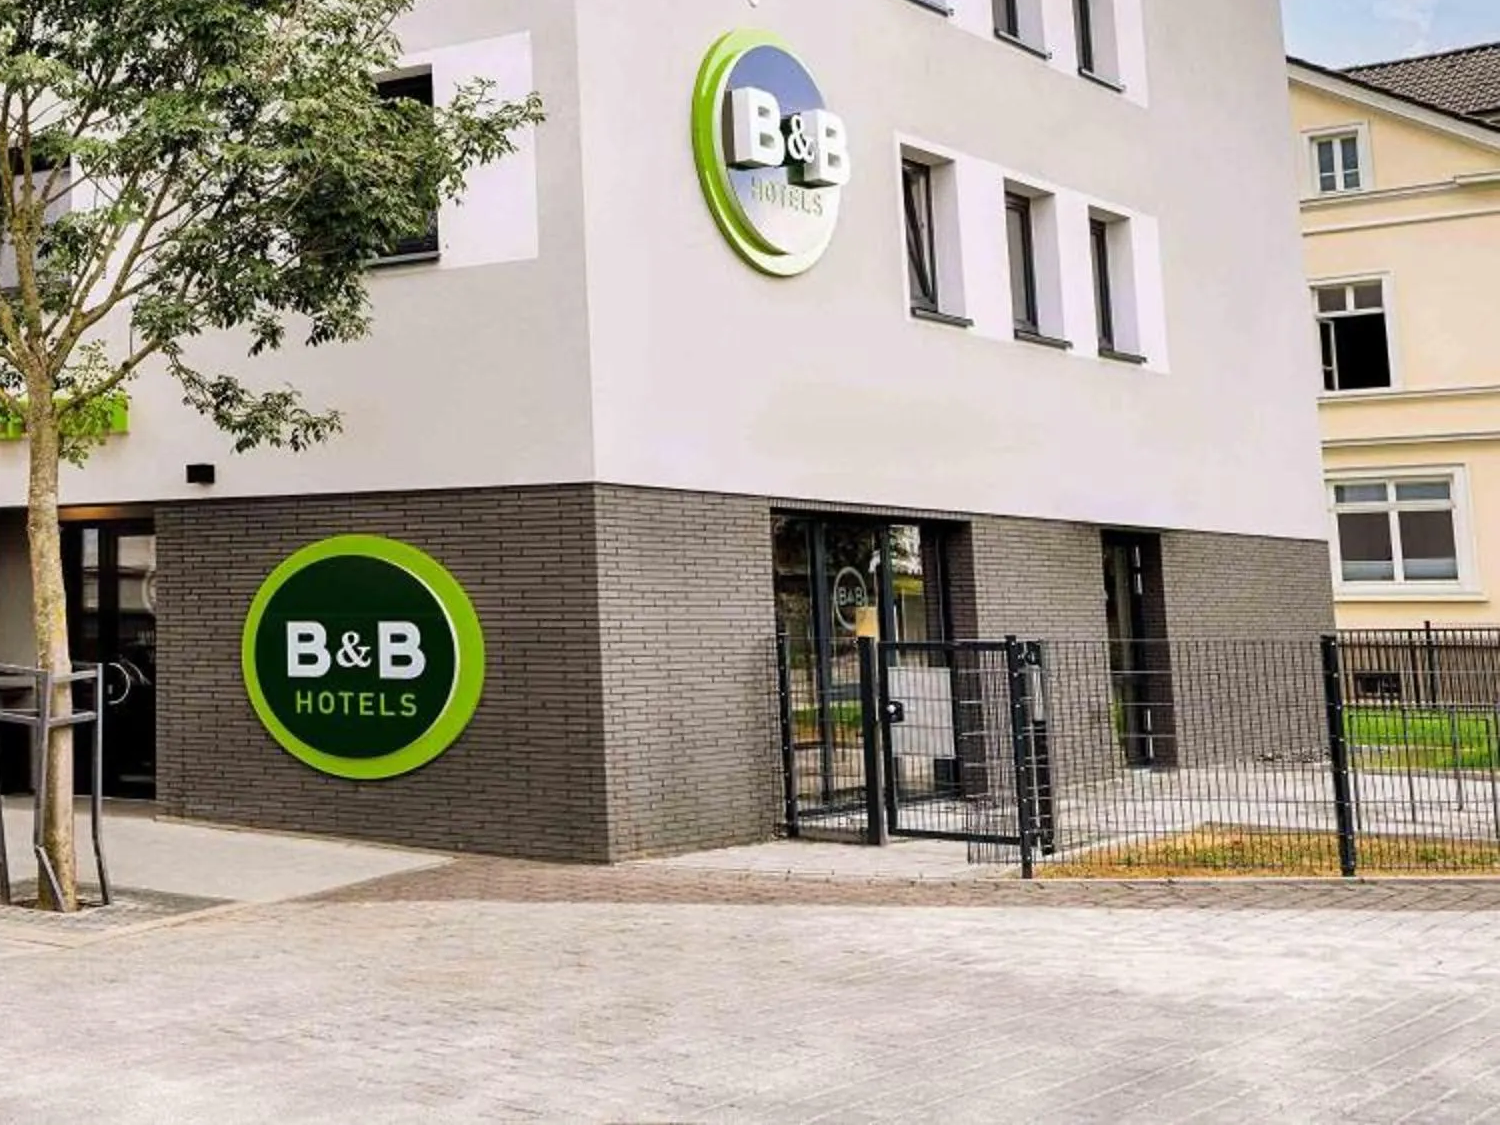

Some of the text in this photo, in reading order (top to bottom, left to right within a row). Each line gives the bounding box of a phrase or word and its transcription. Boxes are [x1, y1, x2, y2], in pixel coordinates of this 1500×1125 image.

[731, 86, 850, 187] B&B
[751, 176, 824, 217] HOTELS
[286, 620, 427, 680] B&B
[294, 690, 418, 717] HOTELS
